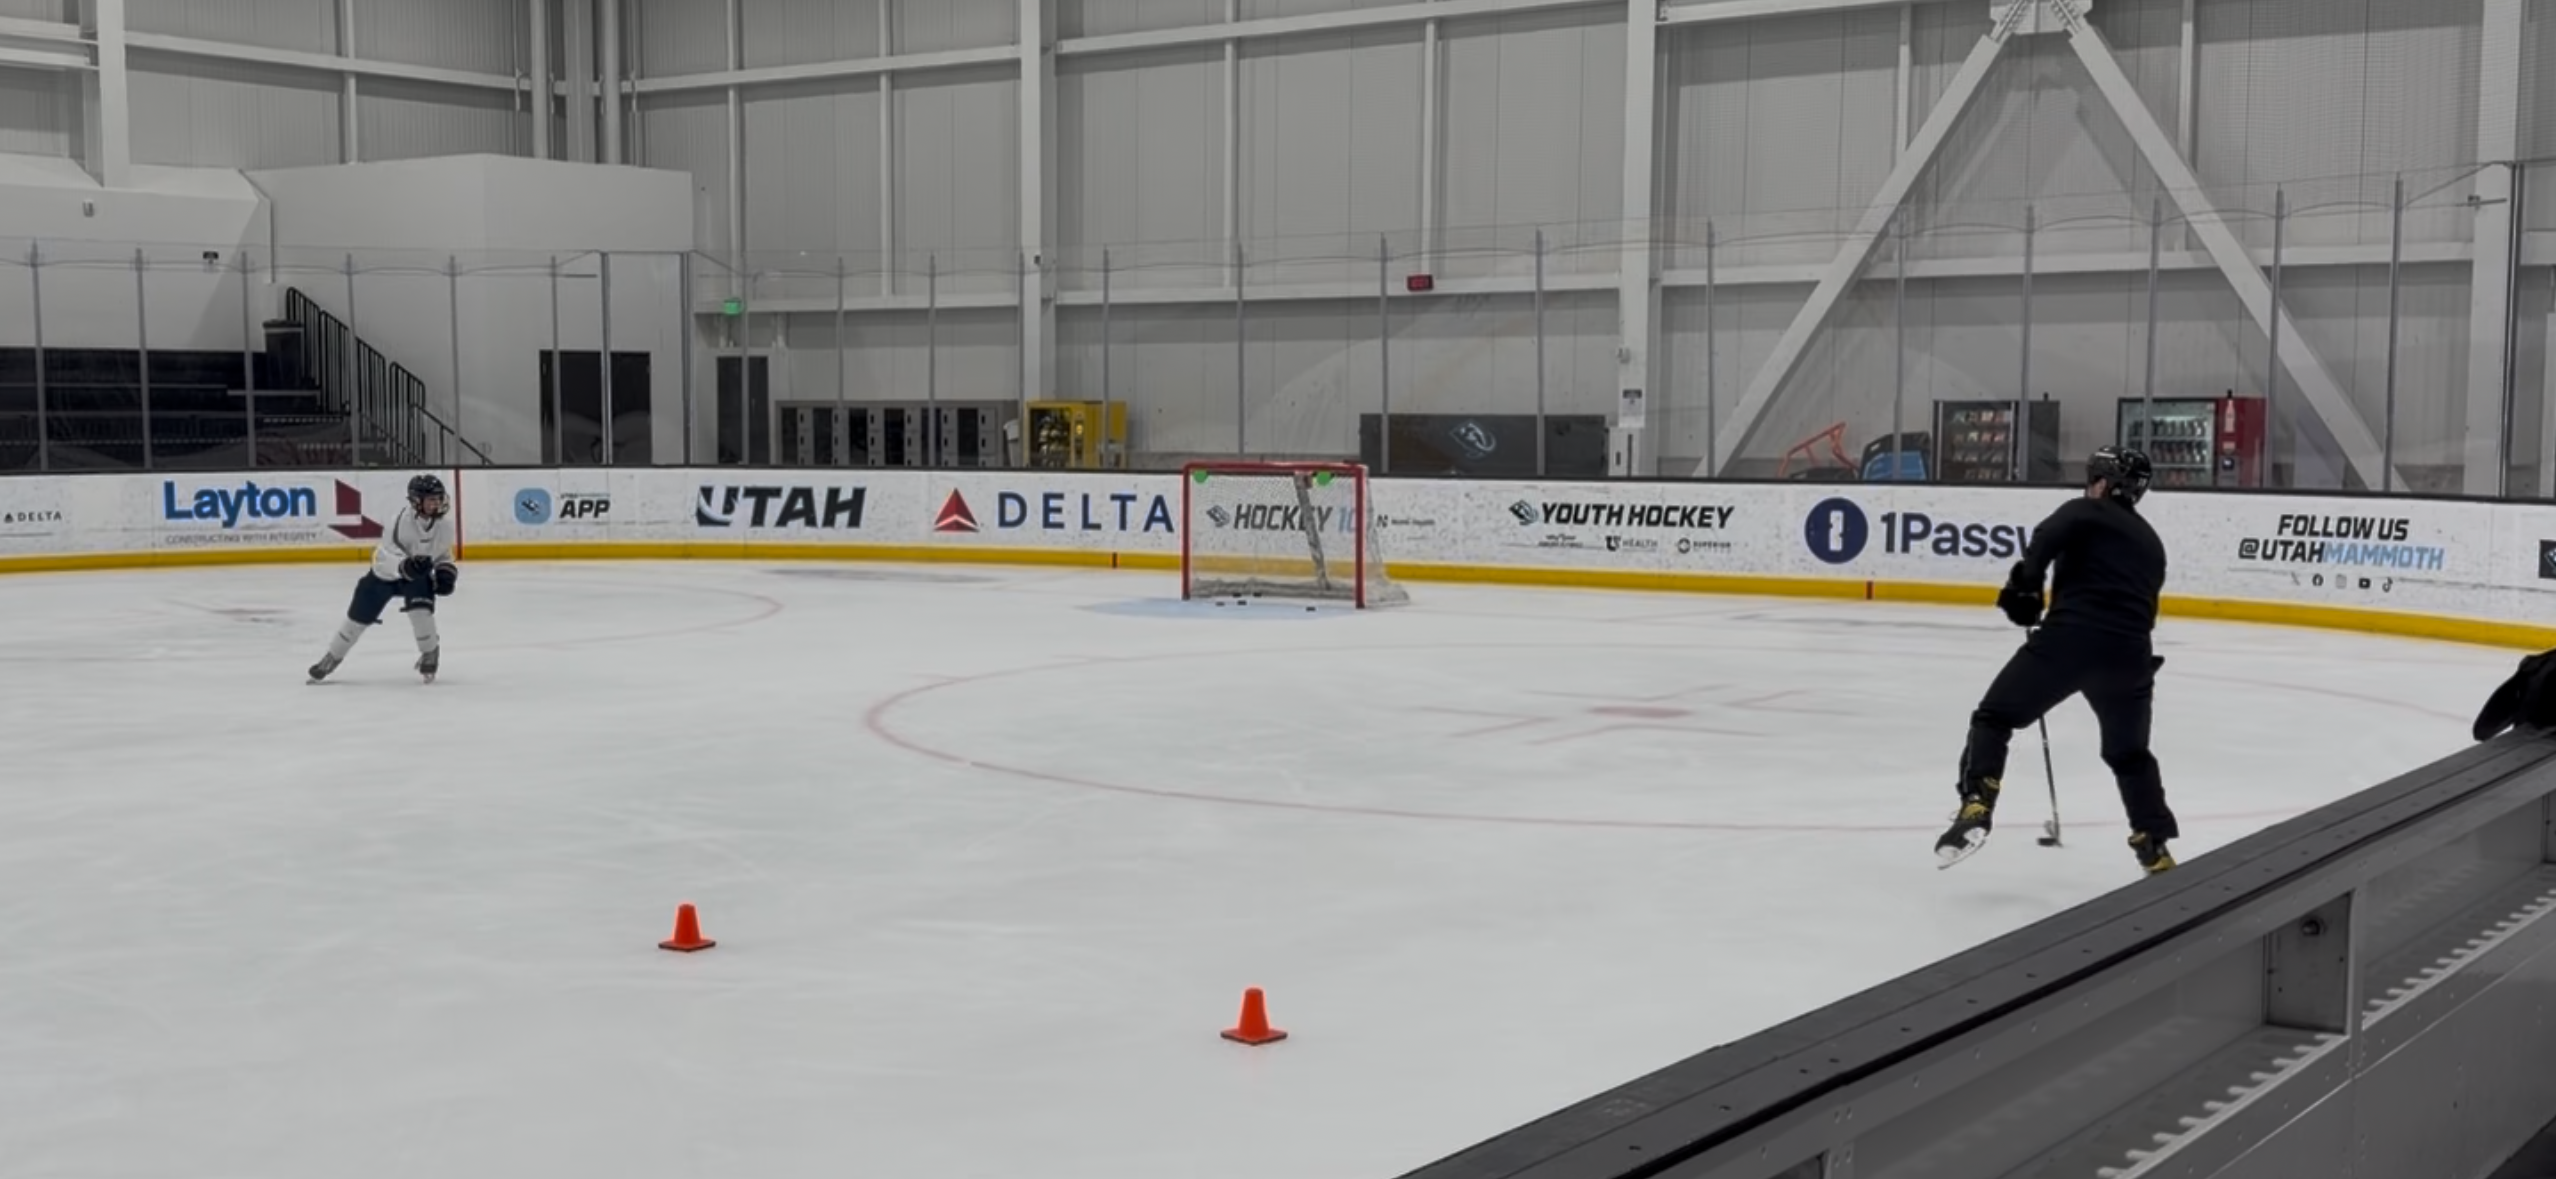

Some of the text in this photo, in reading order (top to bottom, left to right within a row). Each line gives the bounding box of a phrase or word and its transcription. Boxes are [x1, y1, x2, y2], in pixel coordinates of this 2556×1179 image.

[17, 511, 62, 522] DELTA
[164, 481, 316, 529] Layton
[559, 500, 610, 519] APP
[697, 486, 867, 529] UTAH
[998, 491, 1175, 533] DELTA
[1542, 502, 1735, 529] YOUTH HOCKEY
[2277, 513, 2409, 541] FOLLOW US
[2238, 537, 2444, 571] @UTAHMAMMOTH
